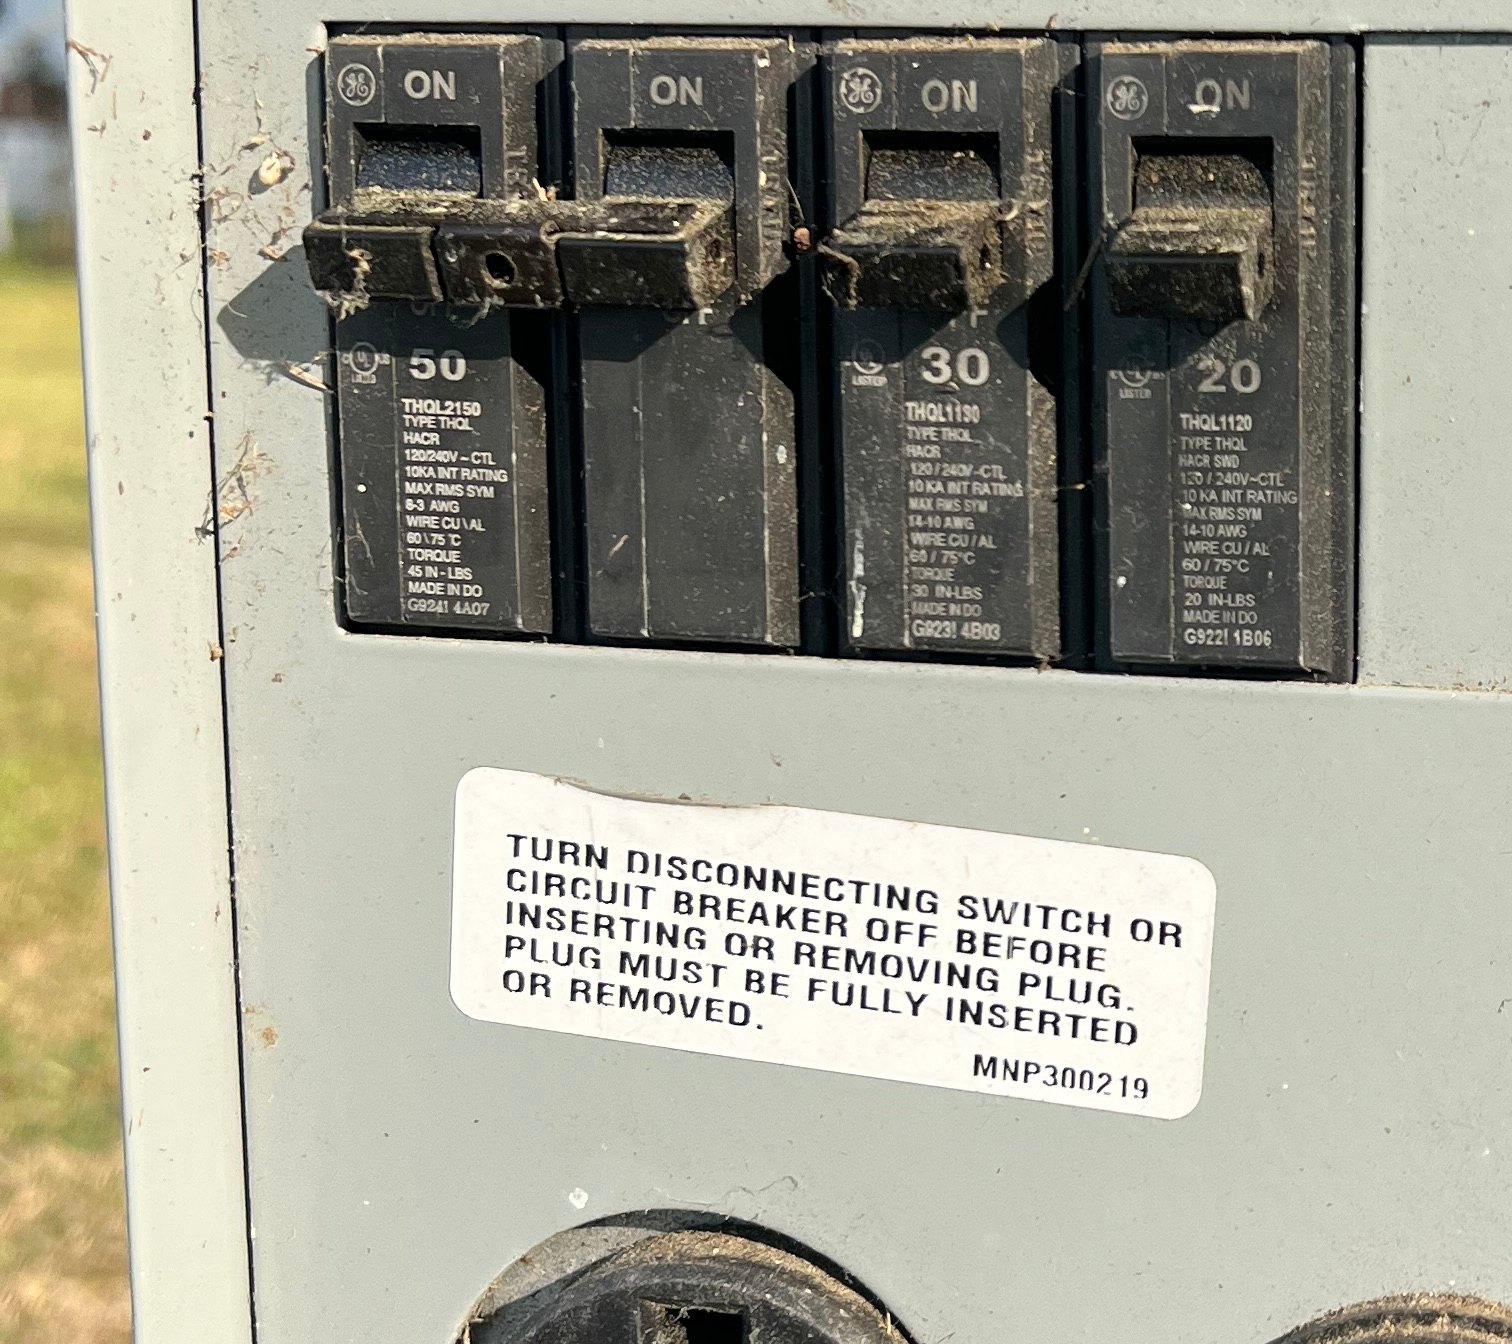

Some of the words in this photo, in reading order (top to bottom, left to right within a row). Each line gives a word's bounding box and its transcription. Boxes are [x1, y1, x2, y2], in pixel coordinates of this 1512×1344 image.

[404, 70, 457, 100] ON
[649, 76, 703, 106] ON
[921, 79, 978, 112] ON
[1194, 78, 1250, 111] ON
[409, 348, 467, 381] 50
[921, 346, 990, 385] 30
[1197, 359, 1262, 393] 20
[401, 398, 482, 416] THQL2150
[403, 414, 437, 428] TYPE
[1180, 413, 1253, 431] THQL1120
[403, 431, 440, 445] HACR
[1181, 437, 1212, 451] TYPE
[437, 466, 458, 479] INT
[461, 467, 508, 482] RATING
[405, 481, 433, 495] MAX
[466, 484, 495, 498] SYM
[1246, 489, 1298, 504] RATING
[429, 500, 460, 513] AWG
[406, 515, 440, 529] WIRE
[407, 548, 461, 563] TORQUE
[408, 565, 423, 577] 45
[408, 581, 445, 595] MADE
[447, 583, 461, 595] IN
[1183, 575, 1228, 590] TORQUE
[506, 833, 608, 869] TURN
[627, 850, 938, 915] DISCONNECTING
[957, 895, 1111, 938] SWITCH
[1130, 918, 1182, 948] OR
[506, 868, 656, 910] CIRCUIT
[674, 890, 847, 937] BREAKER
[866, 918, 937, 947] OFF
[956, 929, 1106, 972] BEFORE
[506, 901, 706, 950] INSERTING
[725, 933, 774, 960] OR
[794, 941, 999, 992] REMOVING
[1019, 972, 1134, 1011] PLUG.
[505, 935, 601, 969] PLUG
[619, 951, 727, 987] MUST
[745, 969, 789, 998] BE
[808, 978, 927, 1017] FULLY
[946, 997, 1138, 1046] INSERTED
[502, 970, 551, 998] OR
[570, 978, 763, 1030] REMOVED.
[973, 1054, 1149, 1099] MNP300219
